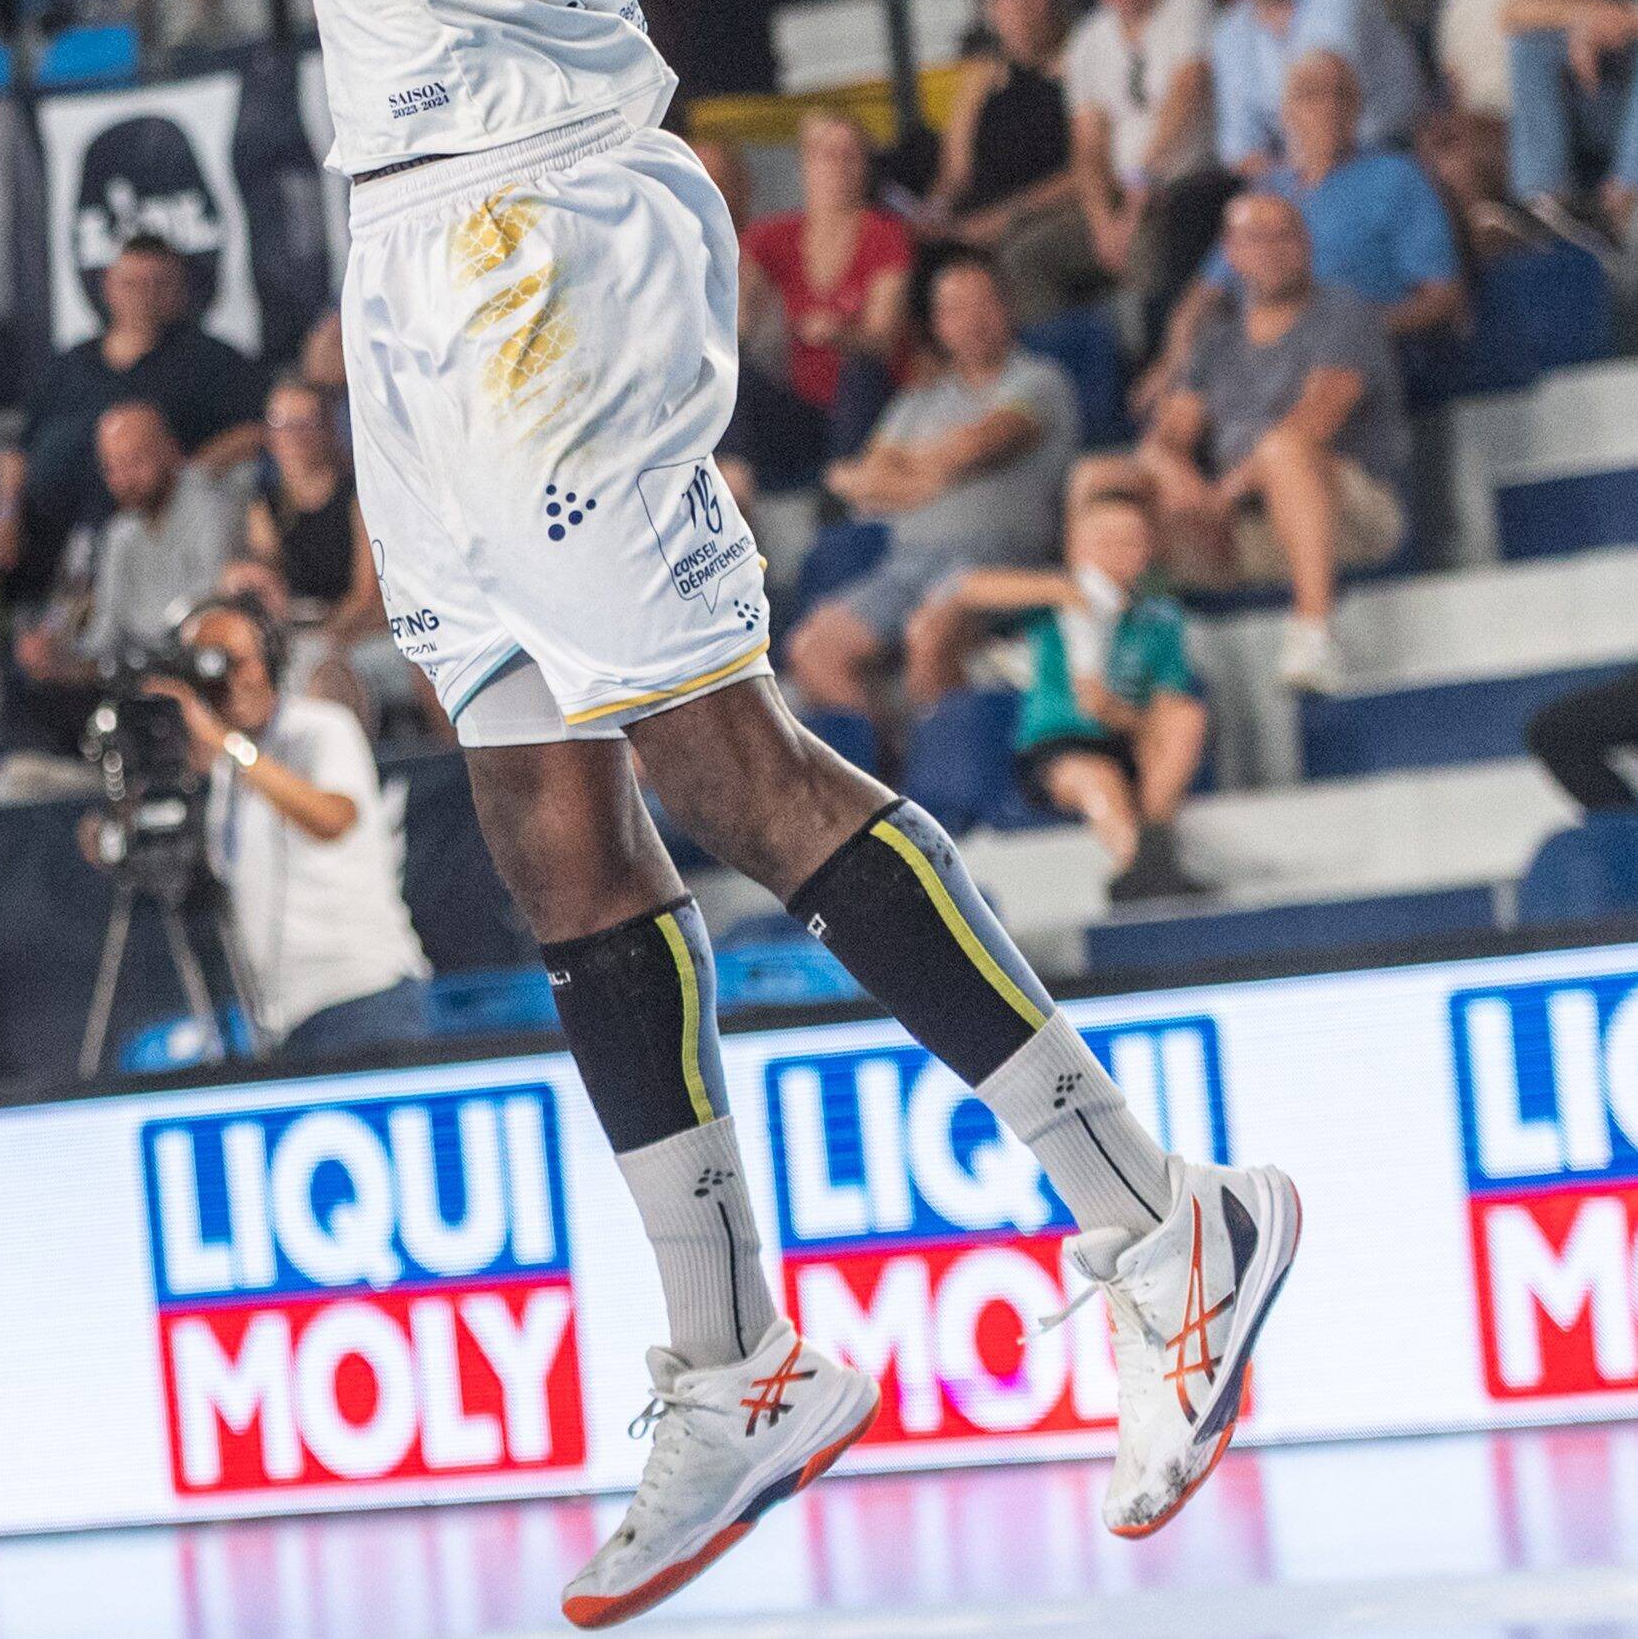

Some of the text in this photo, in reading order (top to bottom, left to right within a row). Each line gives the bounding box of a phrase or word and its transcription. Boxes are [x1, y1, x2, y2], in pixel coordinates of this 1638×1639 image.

[388, 81, 446, 108] SAISON
[150, 1091, 556, 1292] LIQUI
[166, 1283, 572, 1494] MOLY
